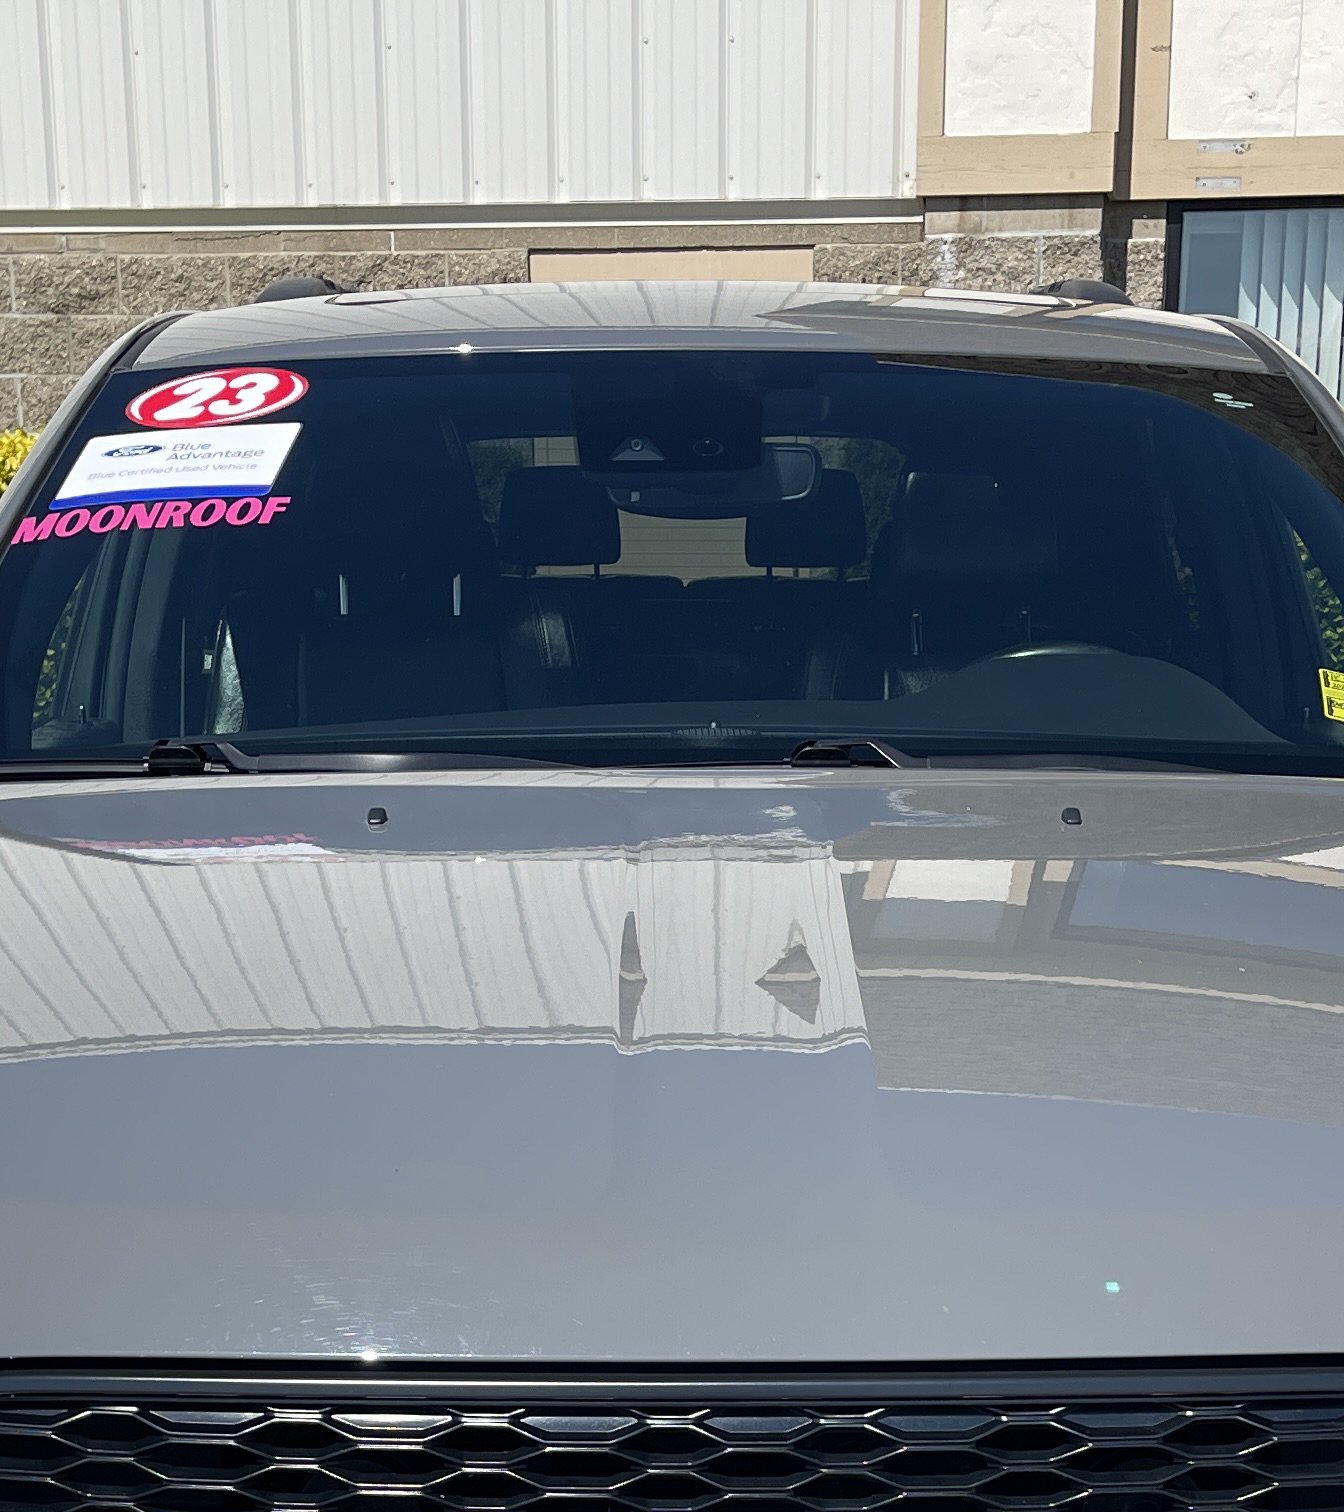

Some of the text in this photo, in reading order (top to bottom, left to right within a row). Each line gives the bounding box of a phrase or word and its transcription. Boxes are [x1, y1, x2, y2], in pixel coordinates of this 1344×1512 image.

[153, 372, 281, 420] 23
[166, 449, 265, 461] Advantage
[172, 442, 211, 451] Blue
[10, 496, 292, 545] MOONROOF
